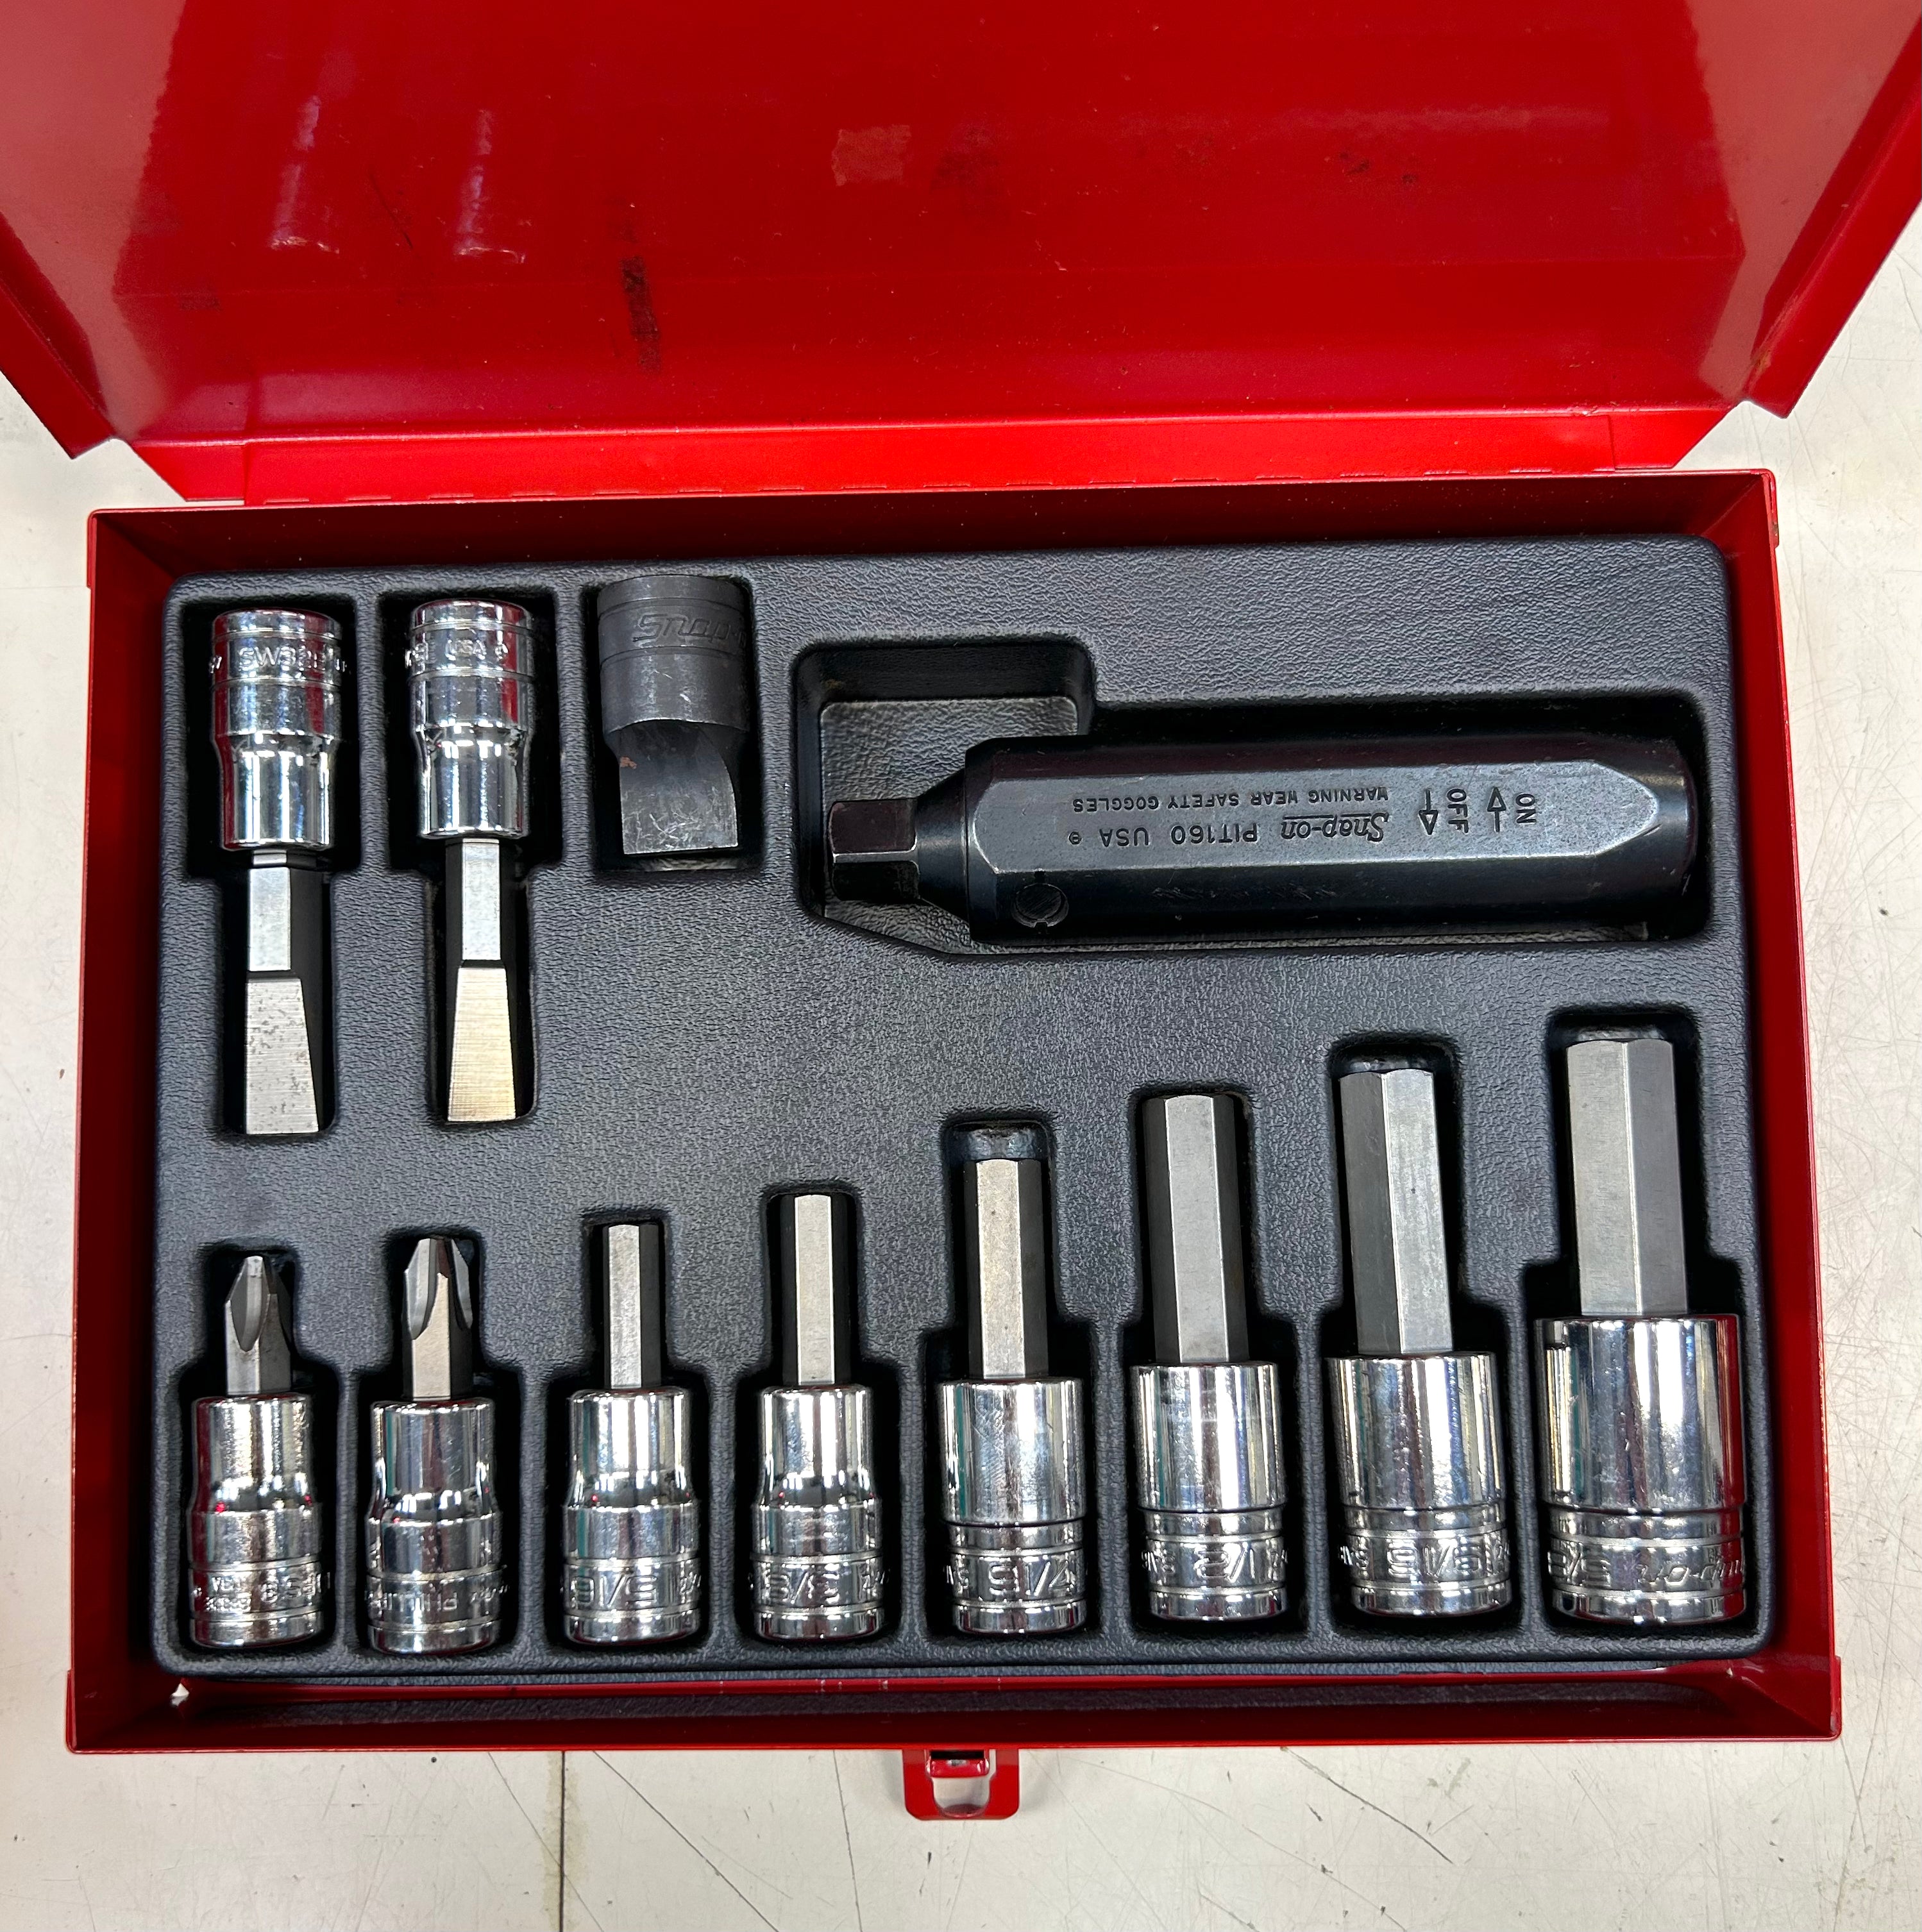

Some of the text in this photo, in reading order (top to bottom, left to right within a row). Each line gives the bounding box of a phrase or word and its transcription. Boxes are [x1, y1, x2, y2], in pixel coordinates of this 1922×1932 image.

[1072, 786, 1389, 812] WARNING WEAR SAFETY GOGGLES
[1447, 787, 1470, 834] OFF
[1516, 793, 1537, 825] ON
[1099, 812, 1390, 846] Snap-on PIT160 USA
